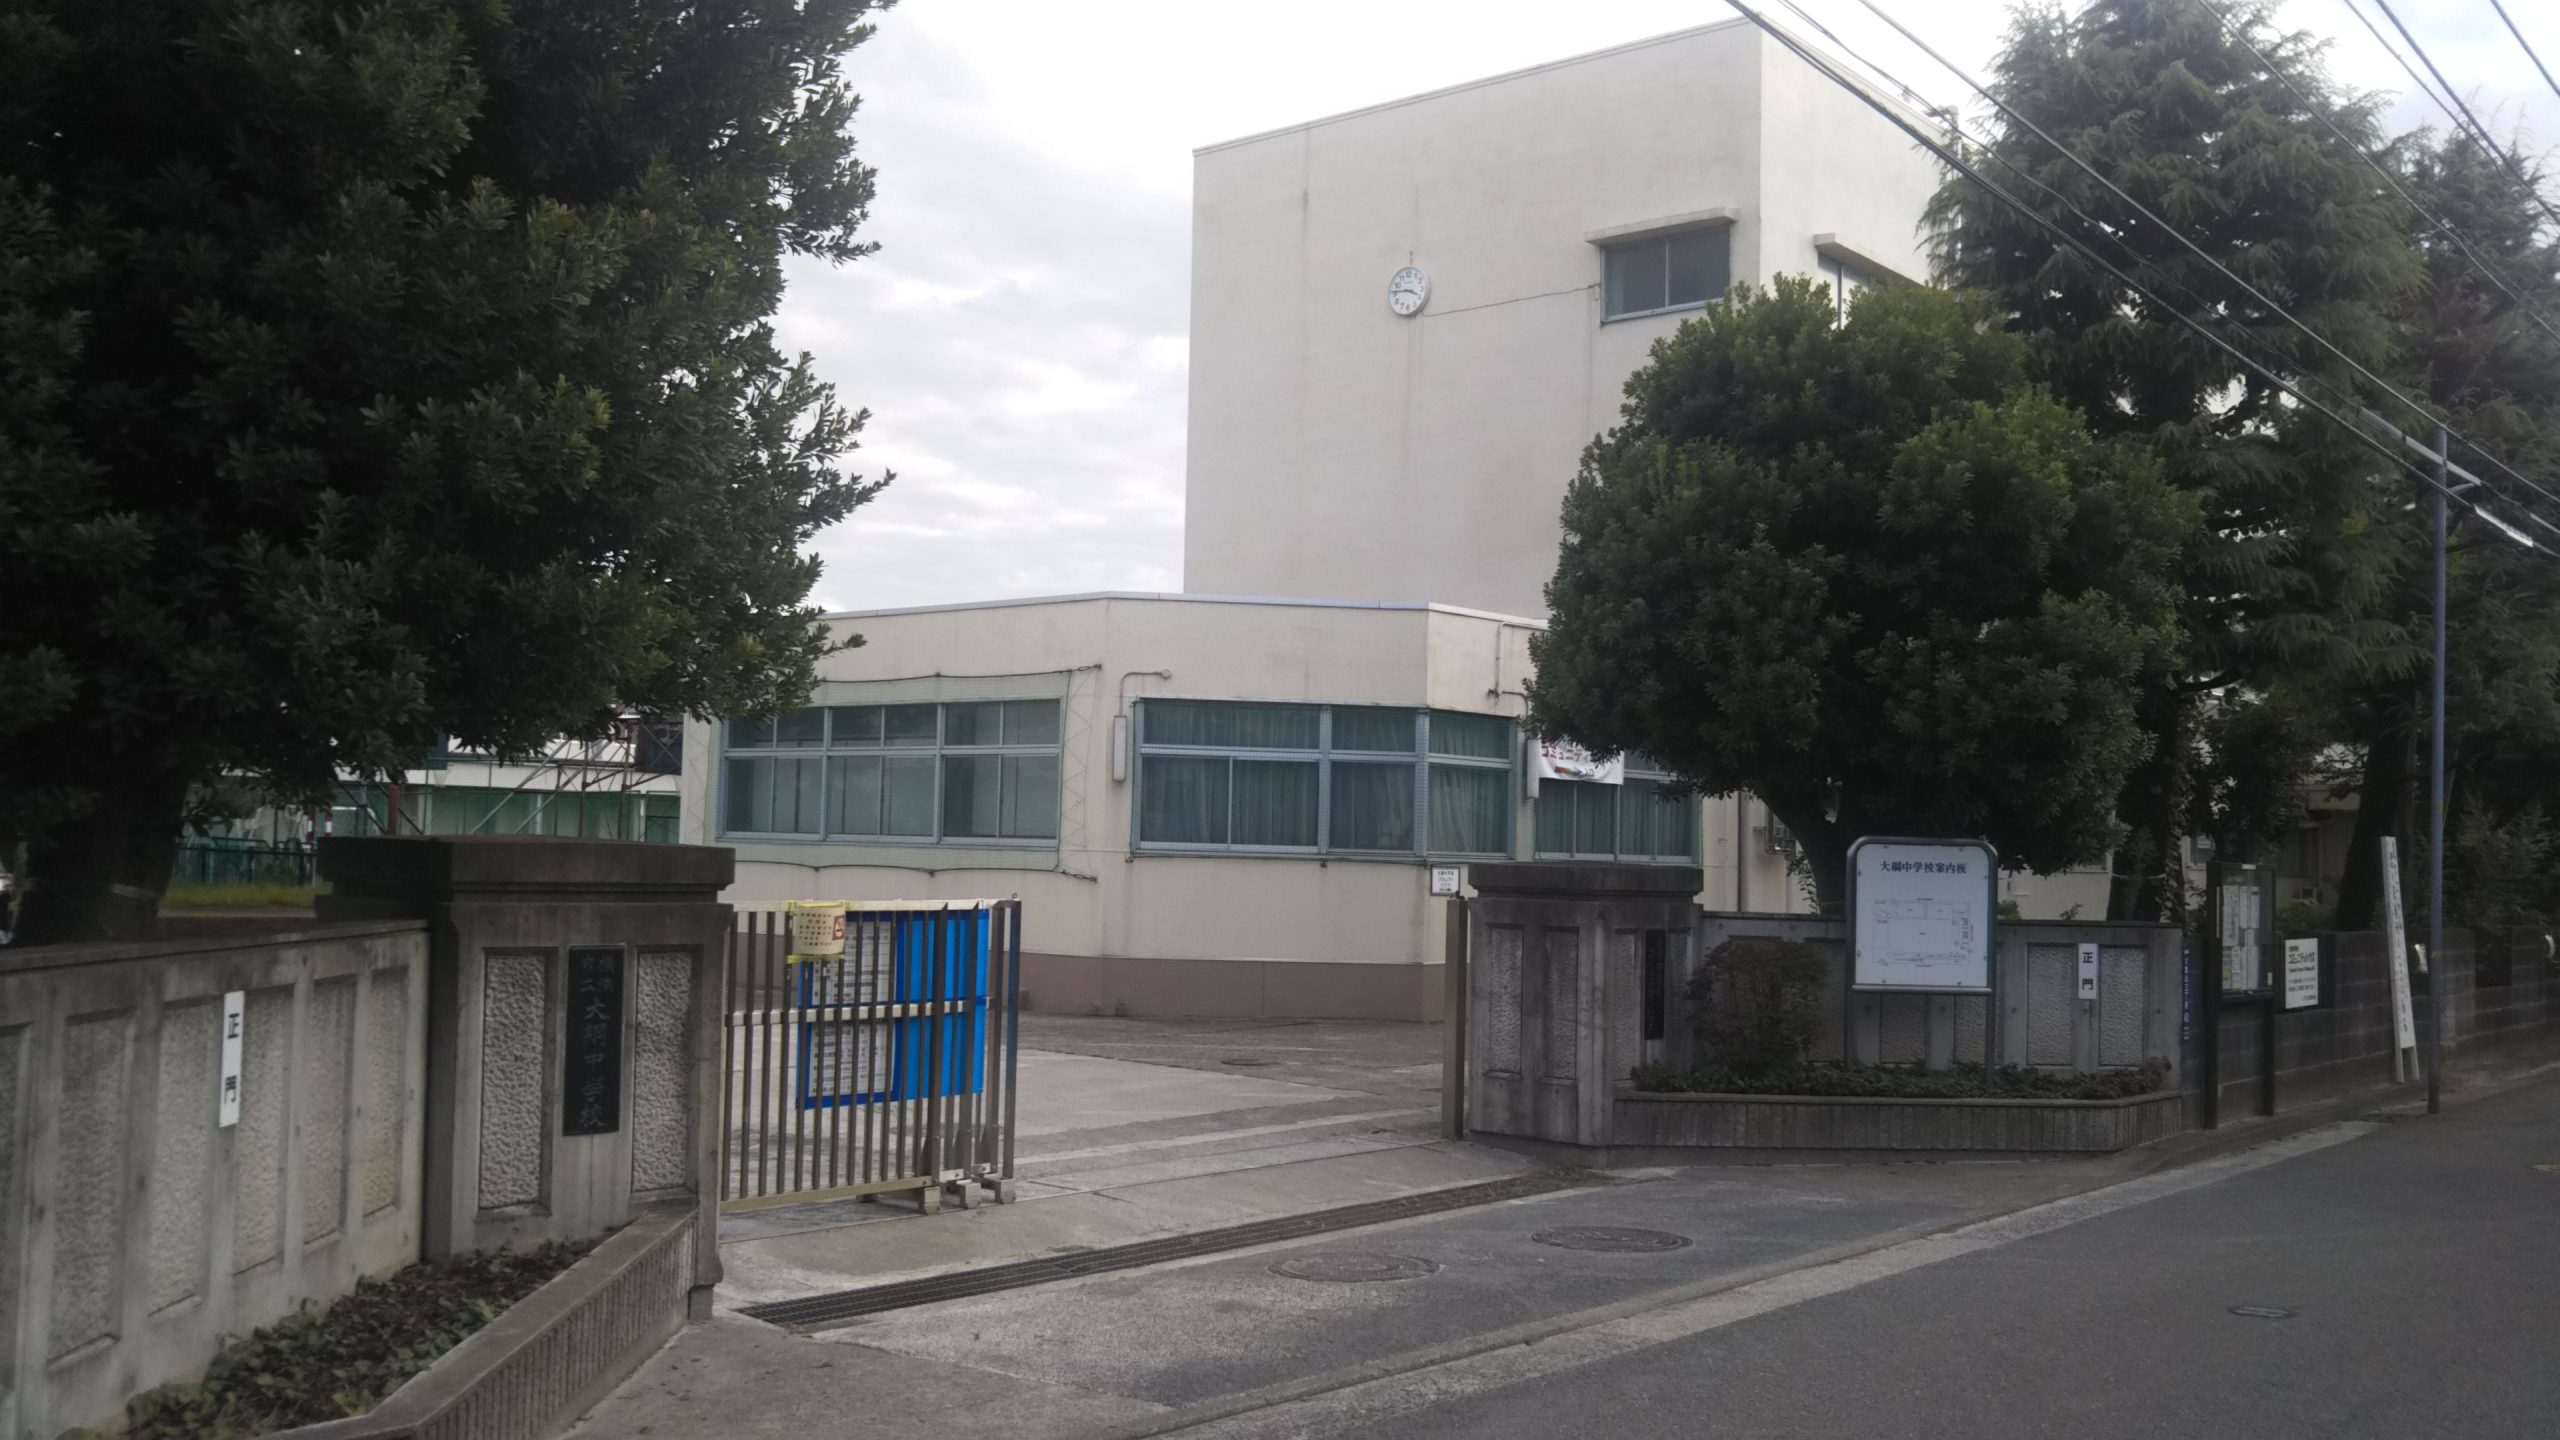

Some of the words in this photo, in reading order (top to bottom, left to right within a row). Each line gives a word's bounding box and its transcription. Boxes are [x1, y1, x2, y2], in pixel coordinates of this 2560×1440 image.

[1880, 860, 1967, 874] 大綱中学校案内板
[2082, 952, 2094, 991] 正門
[225, 1013, 240, 1104] 正門
